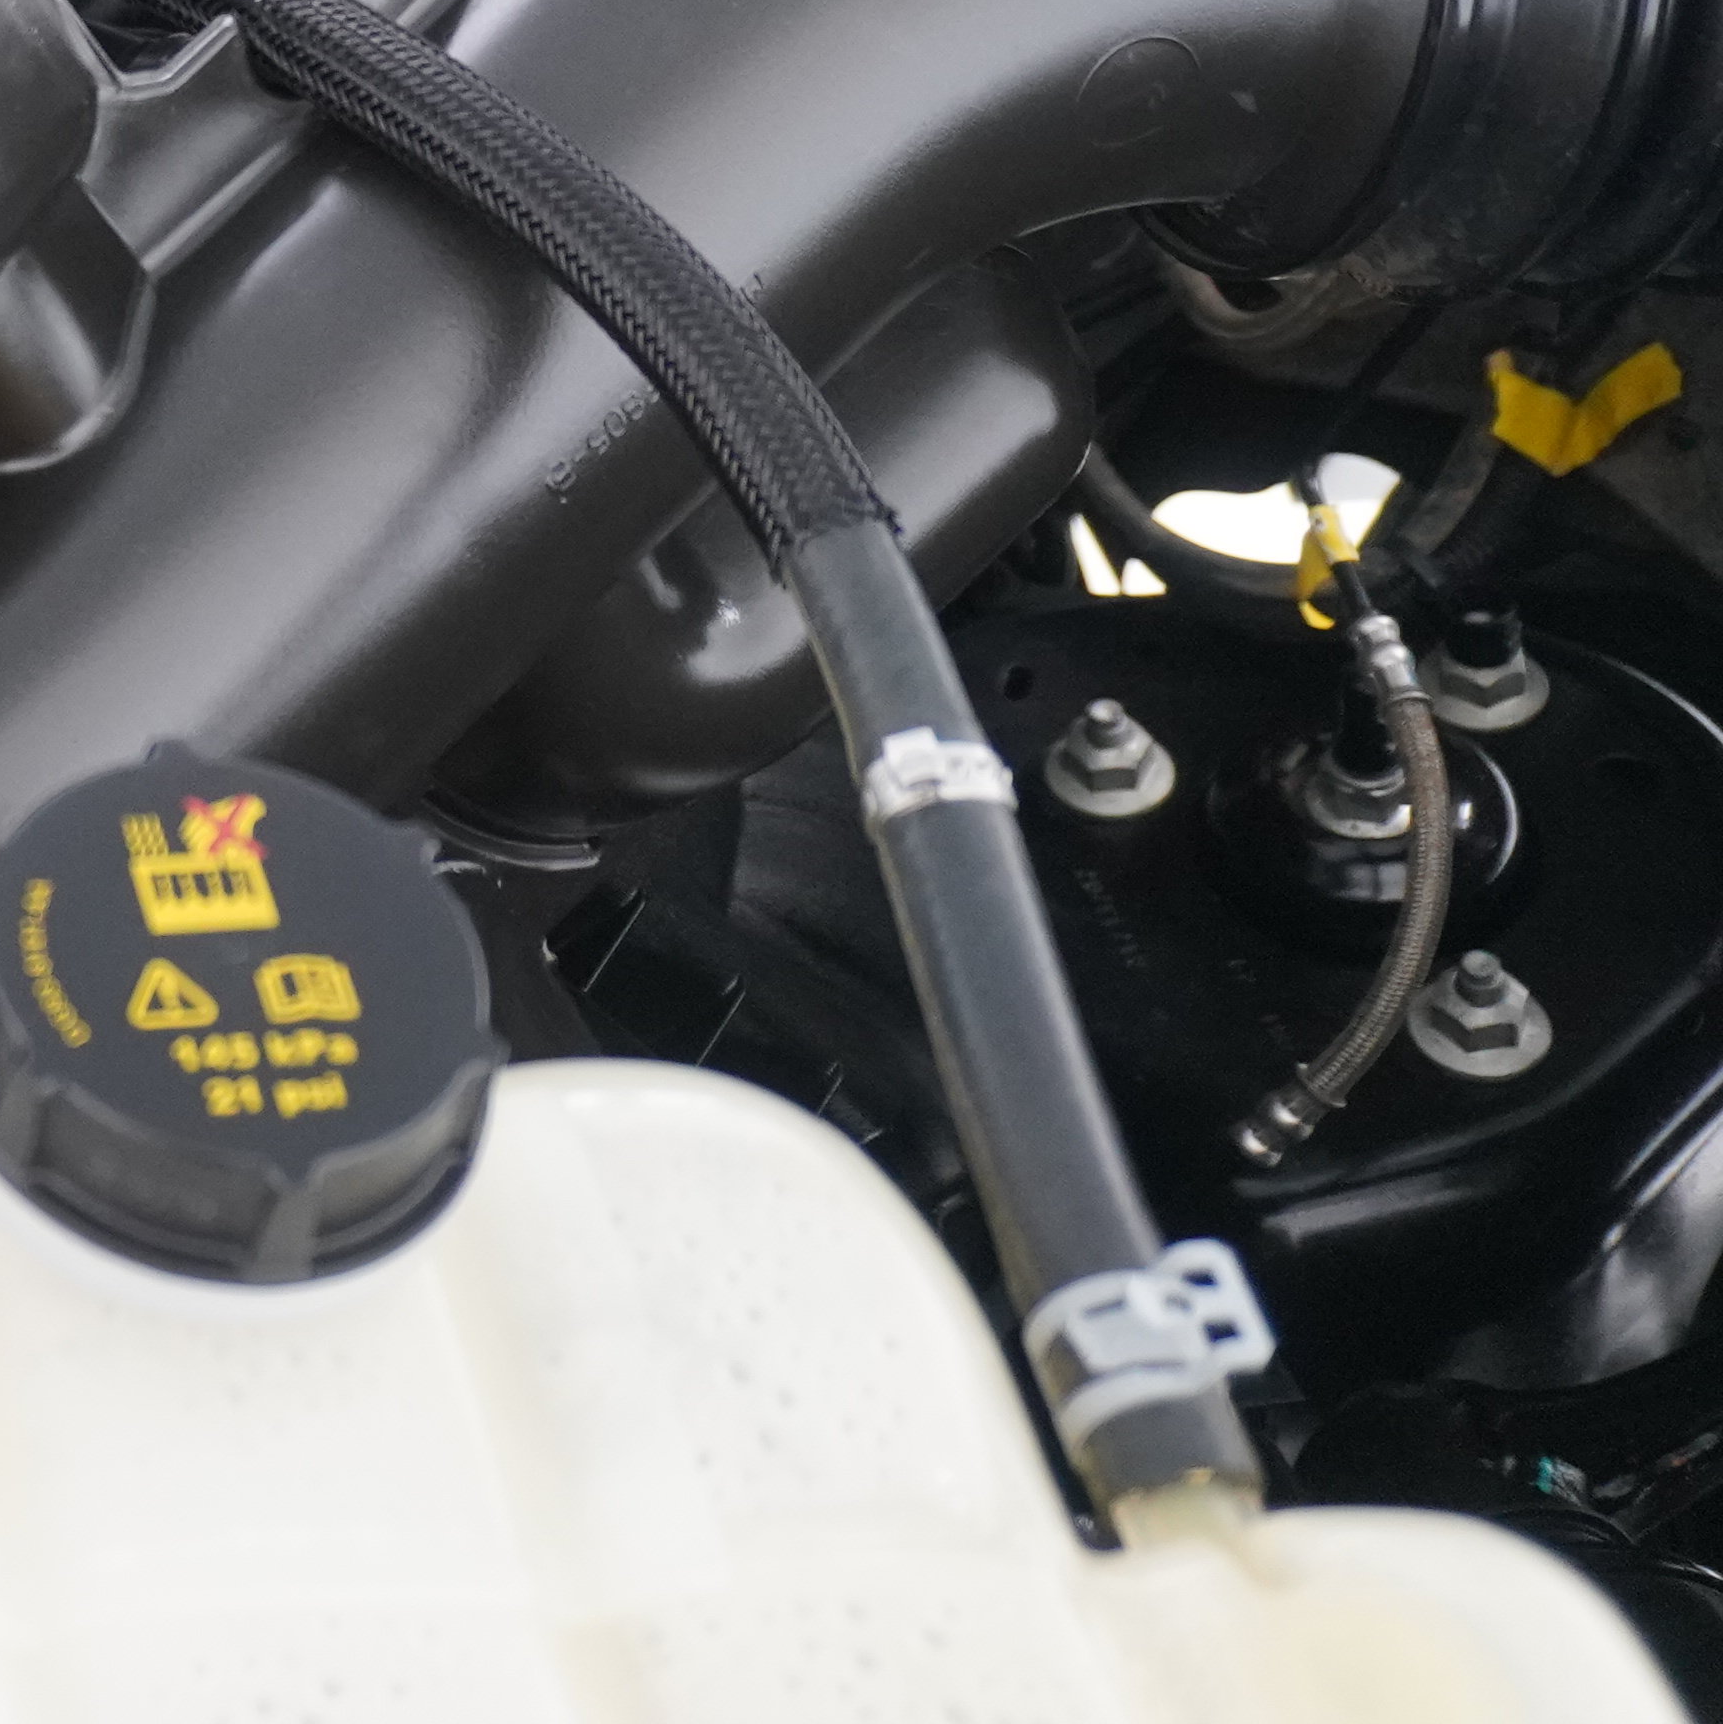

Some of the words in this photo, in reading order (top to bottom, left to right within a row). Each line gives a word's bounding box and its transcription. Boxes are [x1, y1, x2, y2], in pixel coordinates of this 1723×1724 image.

[169, 1032, 261, 1074] 145
[201, 1075, 265, 1119] 21
[272, 1070, 348, 1121] psi
